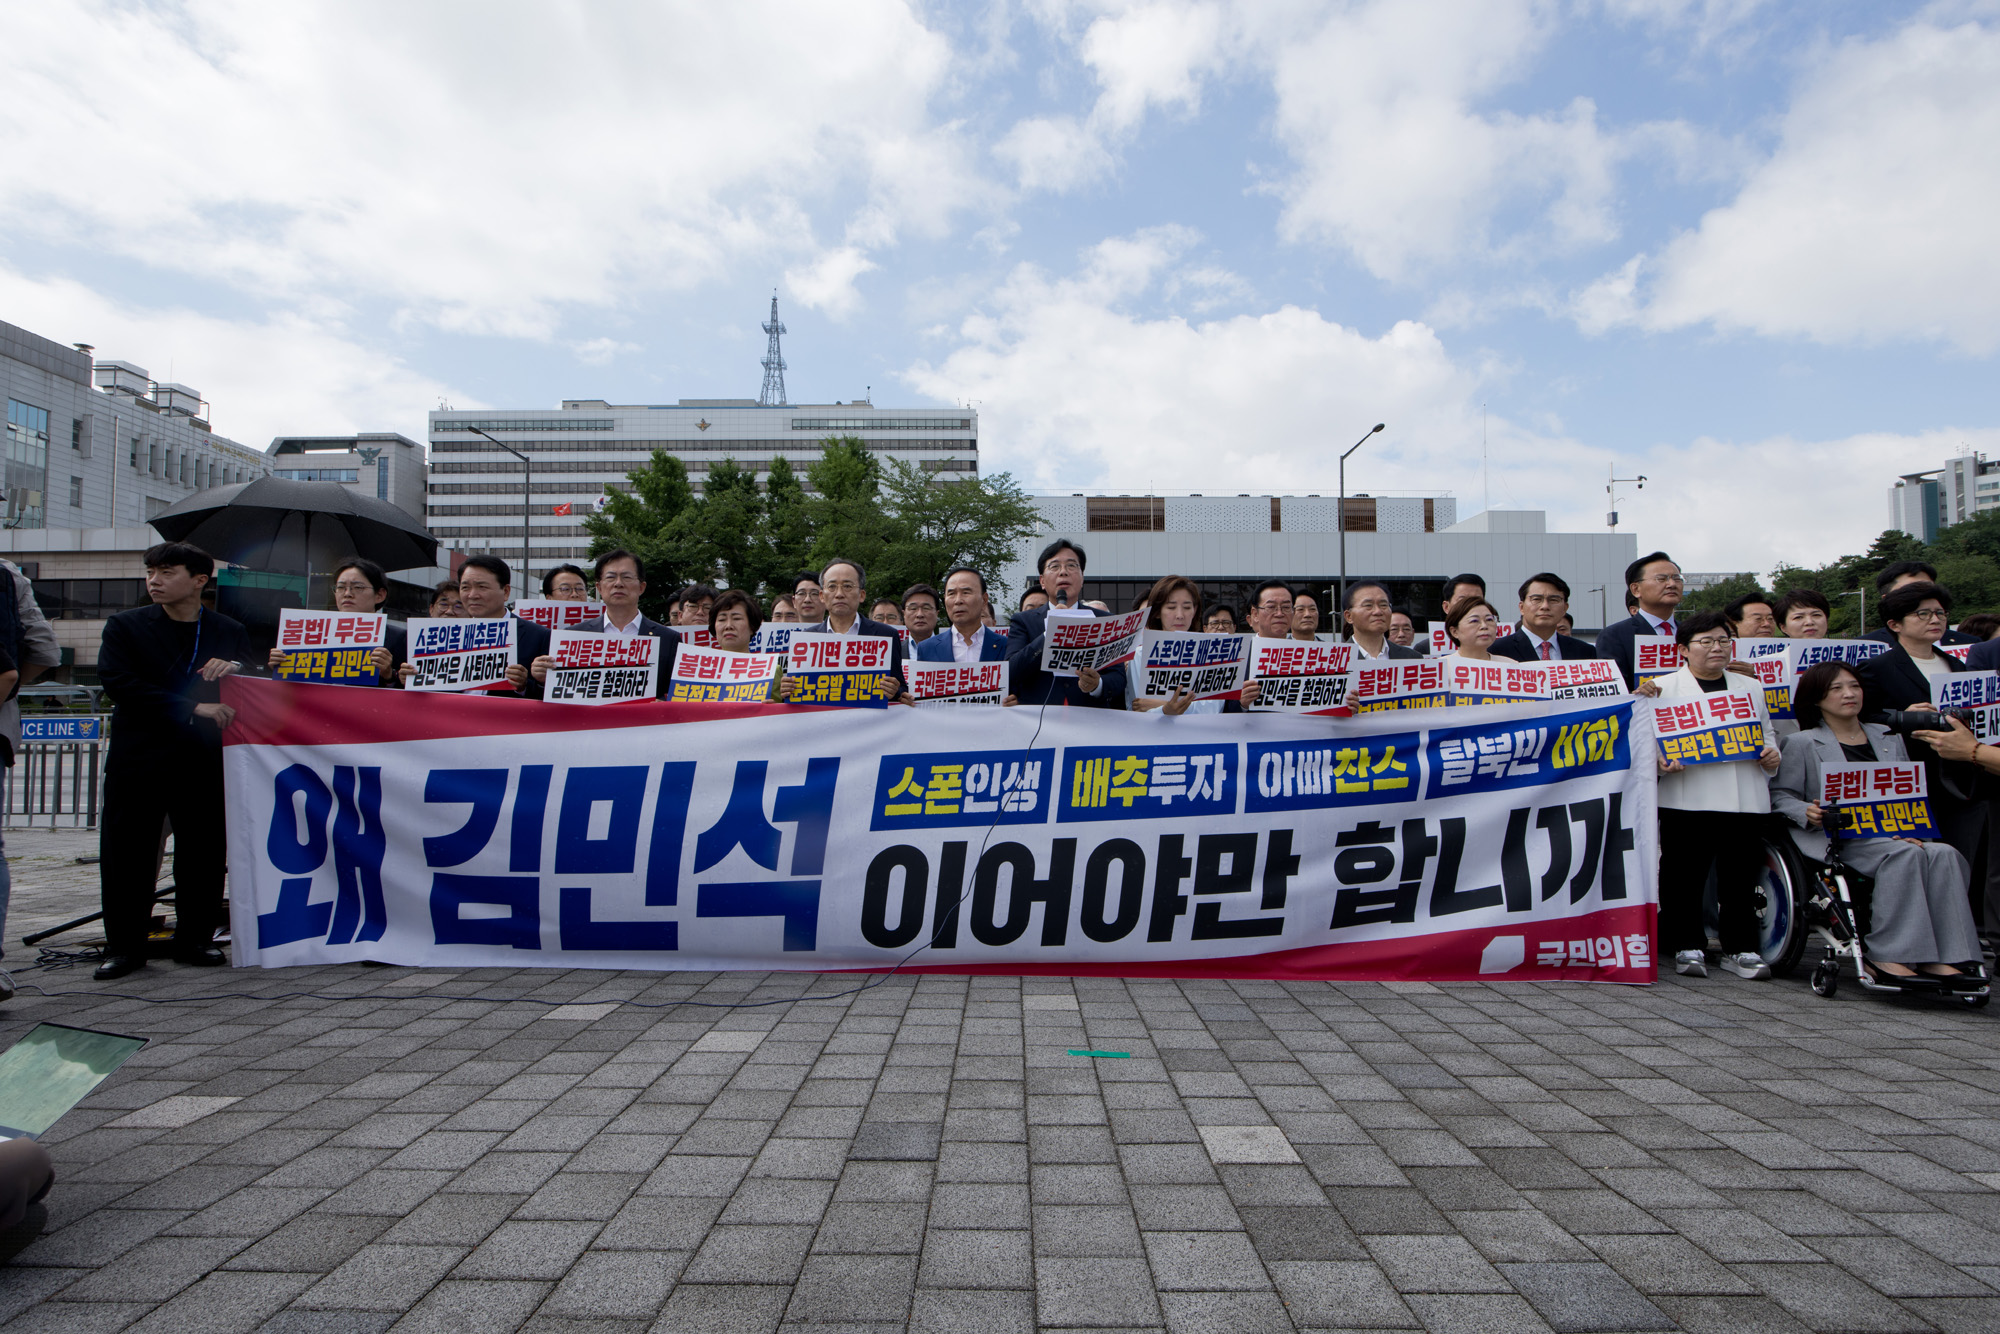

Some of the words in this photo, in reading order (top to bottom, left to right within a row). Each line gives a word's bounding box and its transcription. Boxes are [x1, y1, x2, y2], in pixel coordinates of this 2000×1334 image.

[282, 618, 331, 645] 불법!
[335, 617, 382, 643] 무능!
[414, 625, 461, 655] 스폰의혹
[463, 621, 509, 651] 배추투자
[1053, 623, 1102, 647] 국민들은
[1100, 611, 1144, 645] 분노한다
[278, 652, 328, 679] 부적격
[331, 650, 376, 678] 김민석
[556, 640, 604, 667] 국민들은
[604, 639, 652, 667] 분노한다
[678, 654, 726, 679] 불법!
[729, 656, 774, 679] 무능!
[792, 641, 841, 668] 우기면
[845, 640, 888, 667] 장땡?
[1048, 650, 1096, 672] 김민석을
[1094, 635, 1136, 669] 철회하라
[1147, 639, 1196, 666] 스폰의혹
[1196, 636, 1244, 665] 배추투자
[1258, 648, 1305, 676] 국민들은
[1304, 646, 1352, 675] 분노한다
[413, 656, 460, 686] 김민석은
[461, 652, 508, 682] 사퇴하라
[552, 671, 602, 698] 김민석을
[602, 670, 649, 698] 철회하라
[914, 668, 956, 698] 국민들은
[958, 664, 1001, 694] 분노한다
[1146, 670, 1192, 696] 김민석은
[1192, 666, 1238, 693] 사퇴하라
[1358, 666, 1398, 697] 불법!
[1403, 662, 1444, 691] 무능!
[1455, 666, 1502, 690] 우기면
[1506, 668, 1546, 694] 장땡?
[1569, 662, 1612, 686] 분노한다
[790, 675, 844, 702] 분노유발
[846, 674, 886, 701] 김민석
[1254, 678, 1301, 706] 김민석을
[1300, 678, 1348, 706] 철회하라
[1654, 701, 1706, 733] 불법!
[1708, 693, 1756, 722] 무능!
[48, 722, 74, 736] LINE
[1662, 731, 1718, 761] 부적격
[1718, 724, 1764, 756] 김민석
[884, 760, 1042, 816] 스폰인생
[1071, 753, 1226, 808] 배추투자
[1258, 746, 1410, 798] 아빠찬스
[1439, 727, 1548, 786] 탈북민
[1552, 714, 1620, 769] 비하
[1824, 770, 1867, 801] 불법!
[1874, 765, 1920, 796] 무능!
[1876, 800, 1932, 833] 김민석
[258, 762, 386, 950] 왜
[422, 756, 842, 952] 김민석
[860, 828, 1301, 949] 이어야만
[1330, 792, 1634, 930] 합니까
[1536, 934, 1650, 968] 국민의힘
